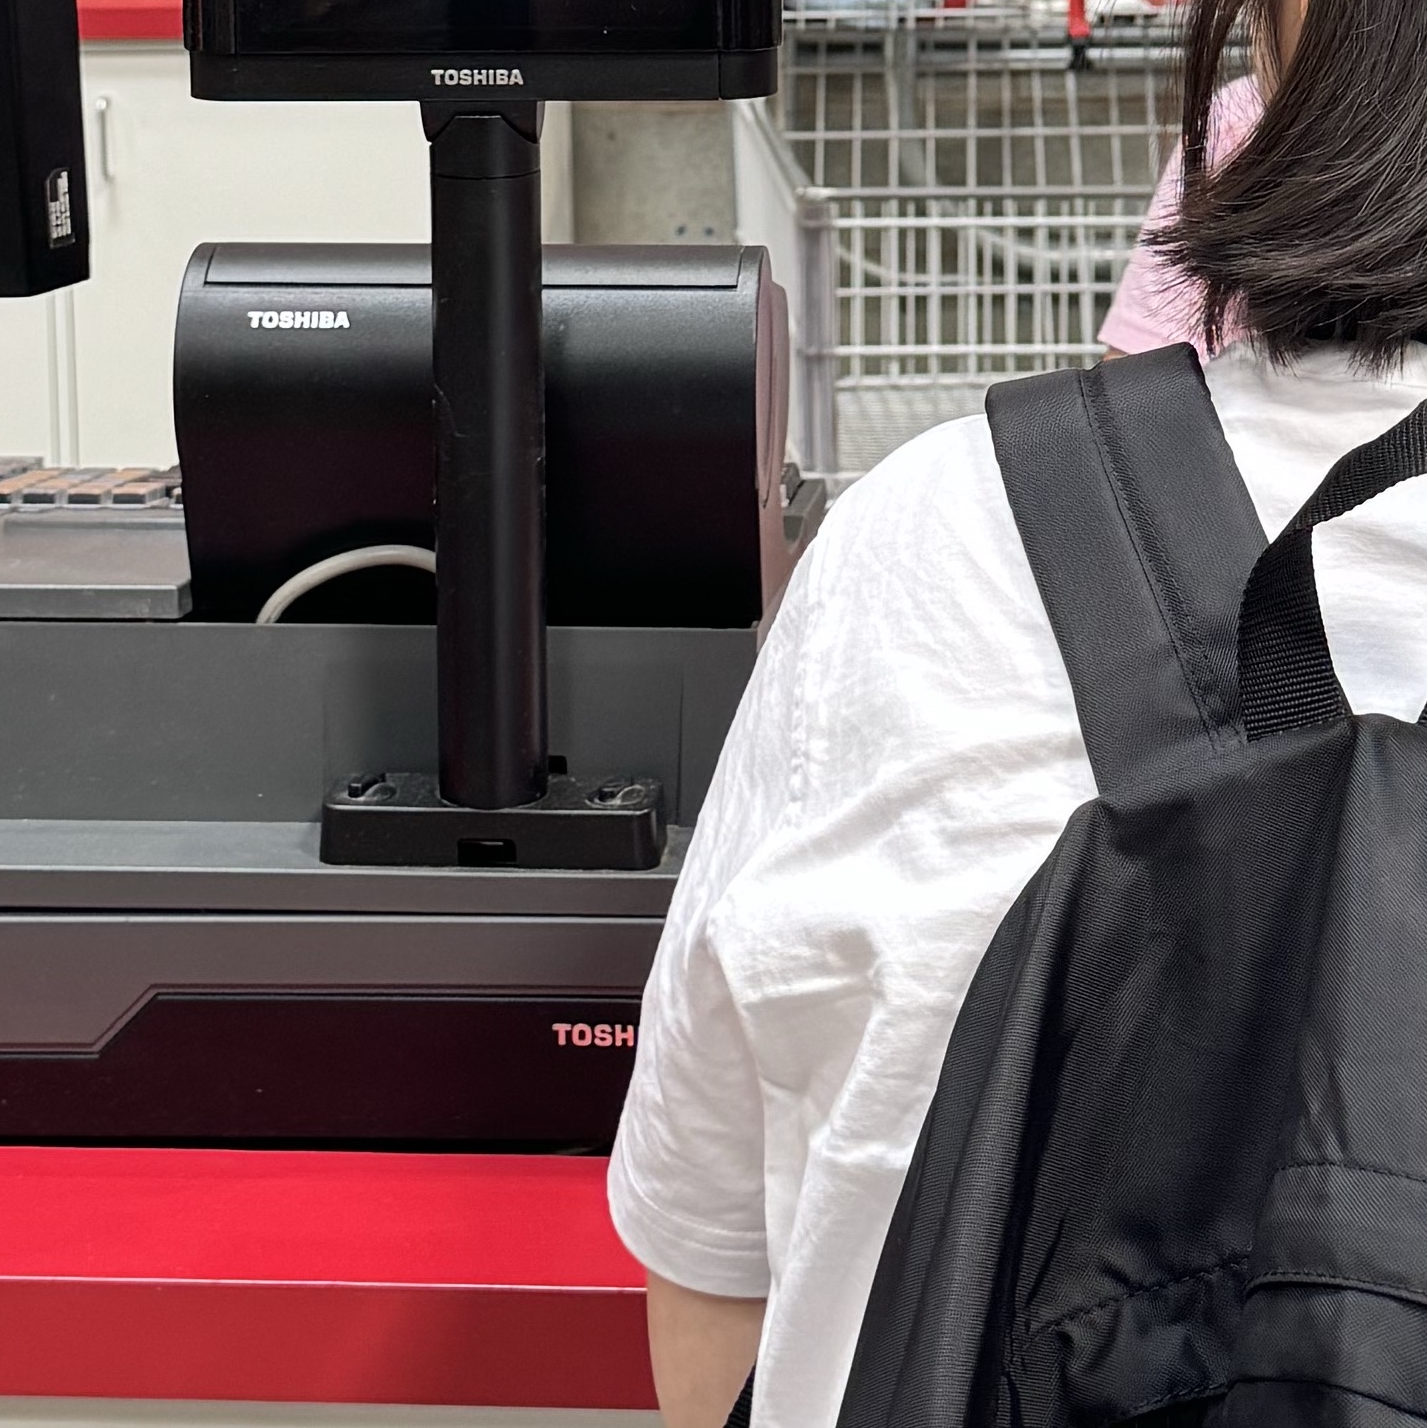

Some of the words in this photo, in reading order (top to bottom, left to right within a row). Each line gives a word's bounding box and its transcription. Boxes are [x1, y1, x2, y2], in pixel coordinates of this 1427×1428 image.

[431, 68, 524, 86] TOSHIBA
[247, 310, 351, 330] TOSHIBA
[552, 1023, 635, 1047] TOSH
